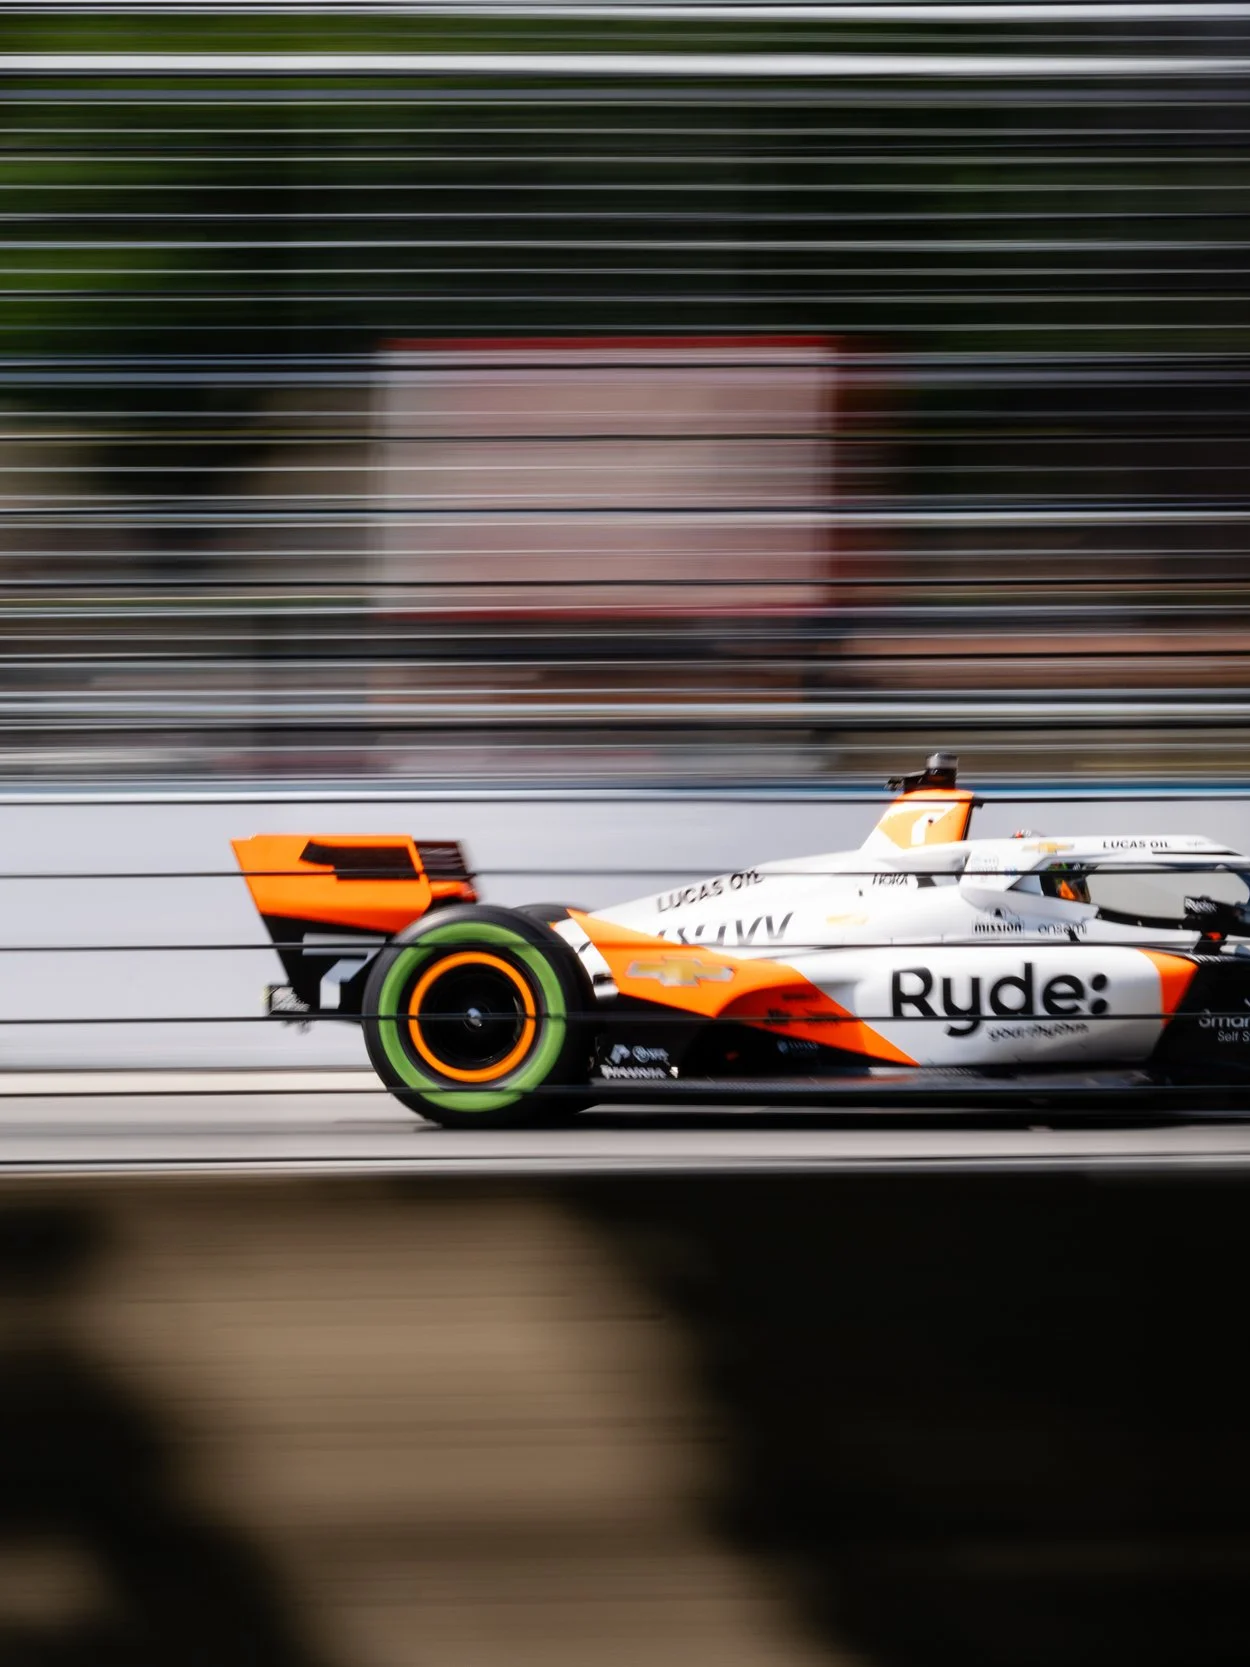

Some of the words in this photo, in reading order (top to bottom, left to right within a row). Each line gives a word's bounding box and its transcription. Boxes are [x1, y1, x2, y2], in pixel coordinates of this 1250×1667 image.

[1103, 840, 1146, 849] LUCAS
[1150, 840, 1171, 849] OIL
[657, 879, 724, 913] LUCAS
[729, 868, 765, 891] OIL
[891, 962, 1109, 1038] Ryde:
[1218, 1030, 1239, 1041] Self
